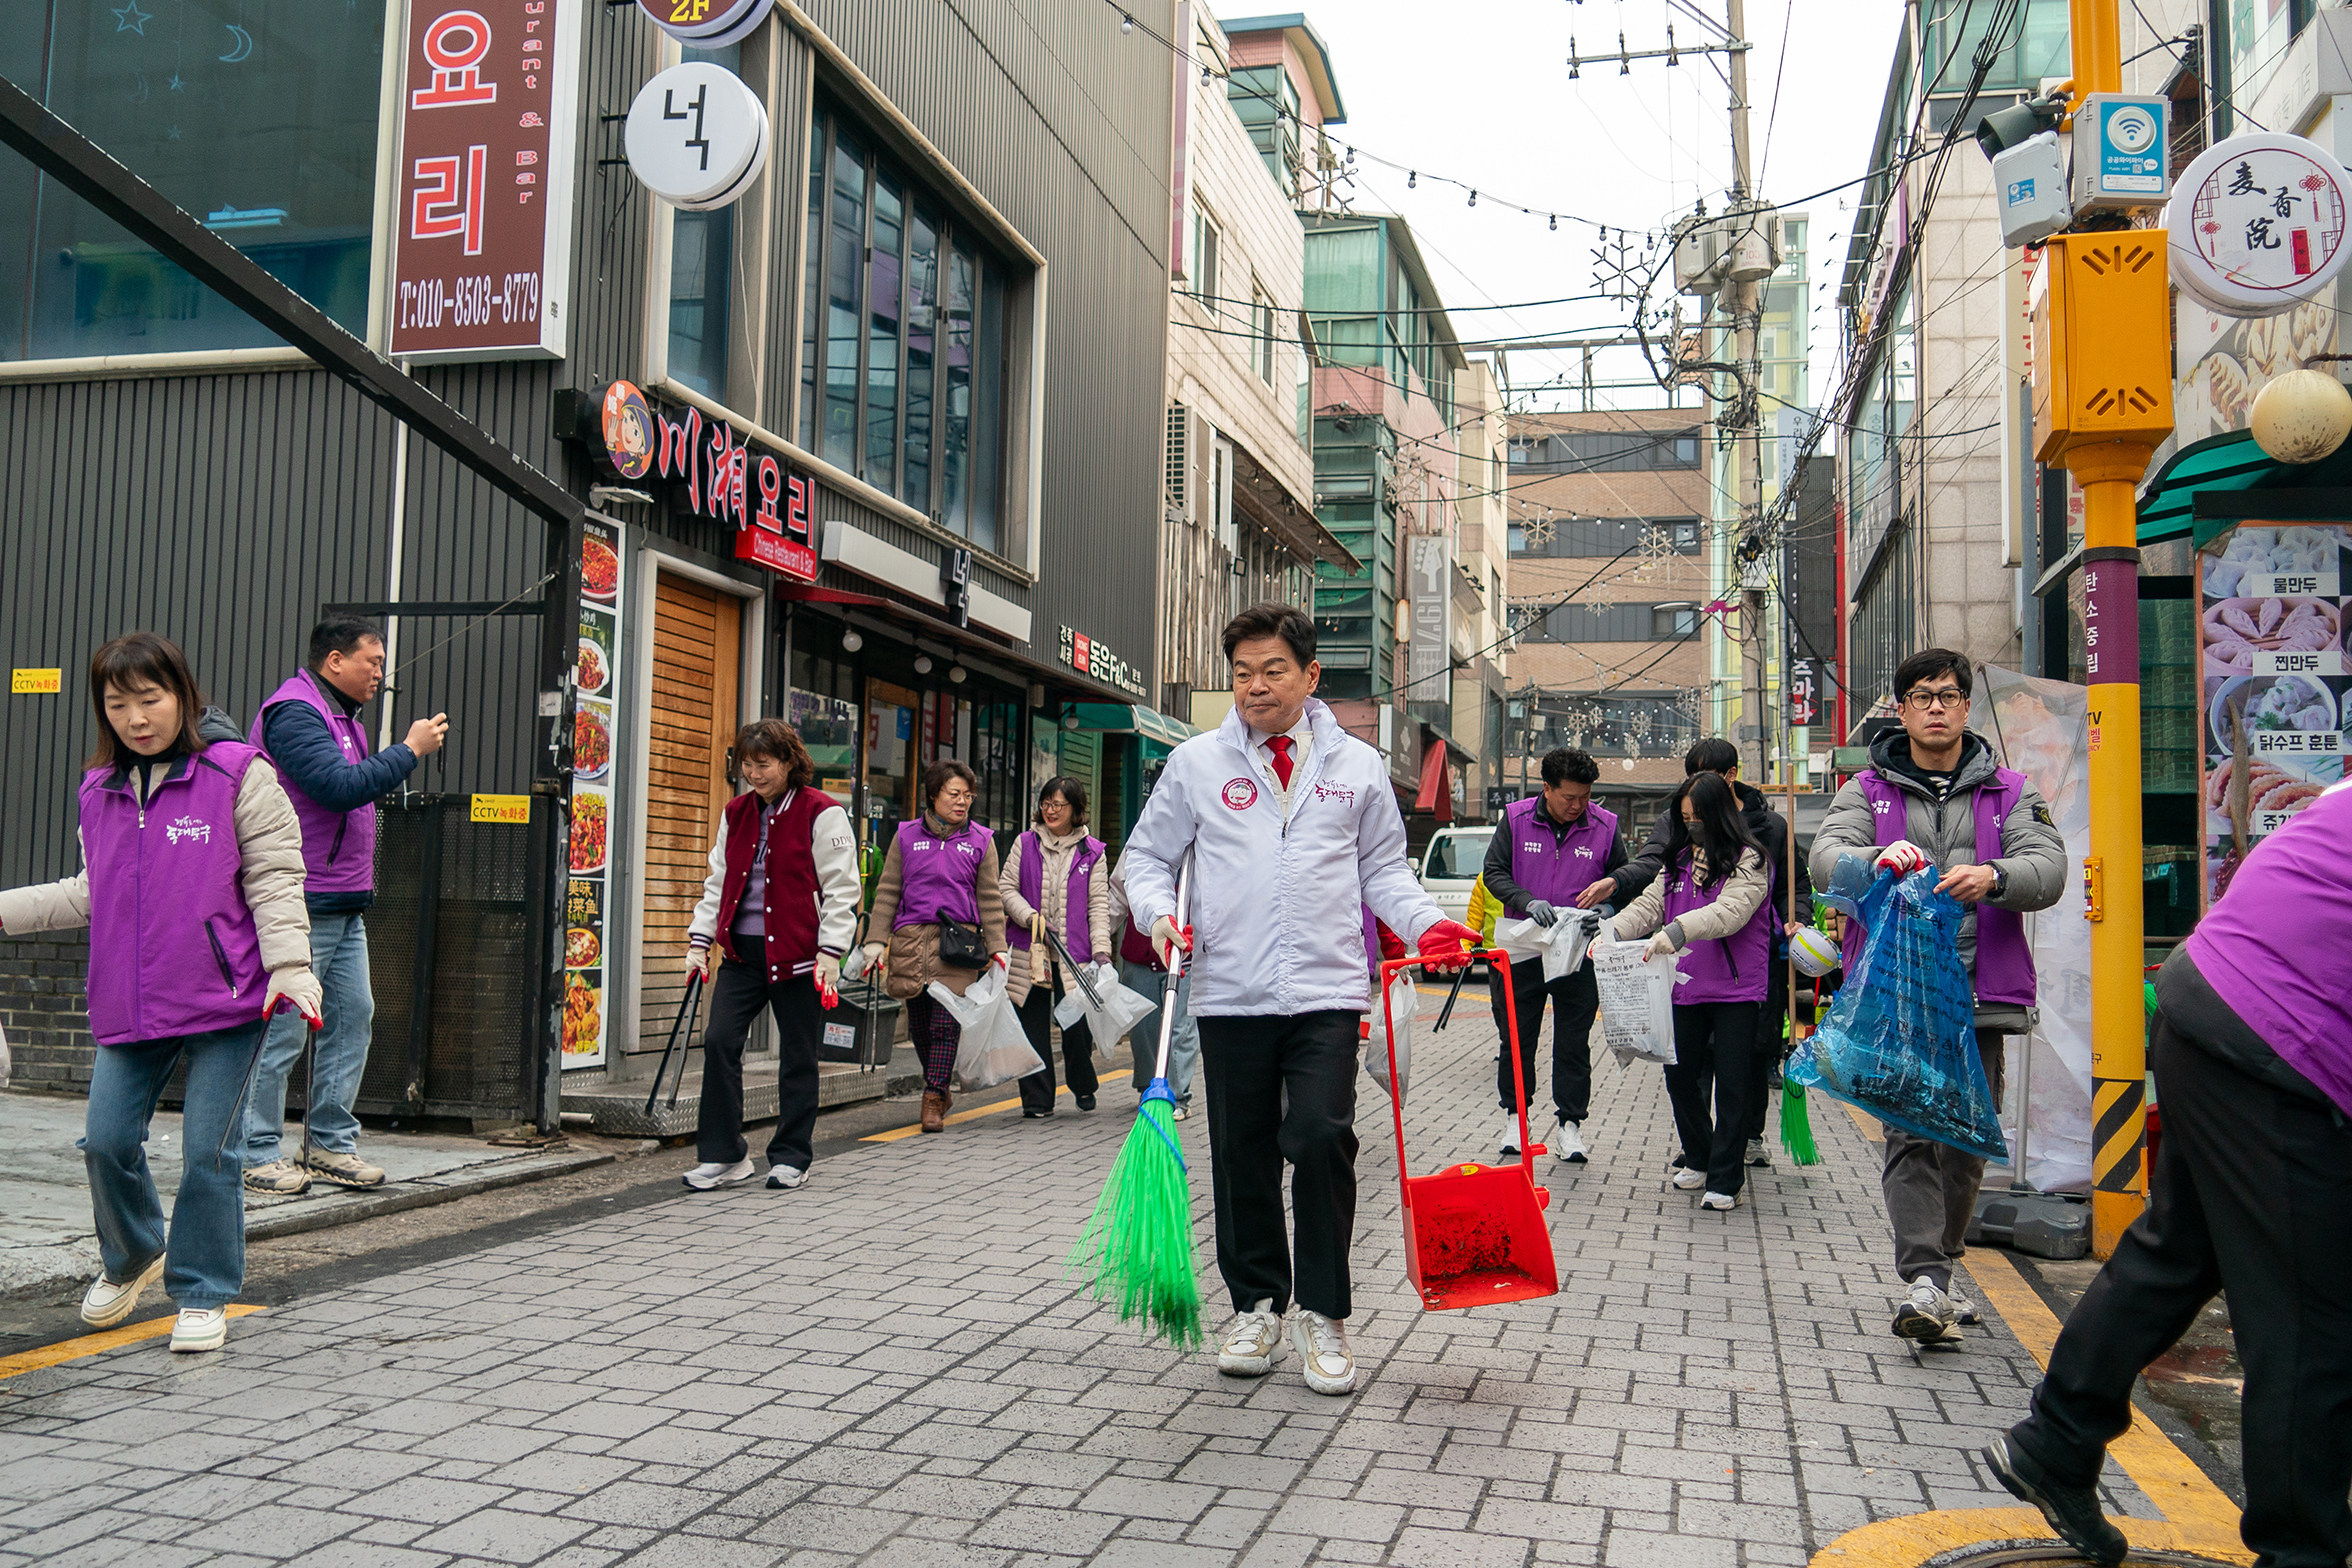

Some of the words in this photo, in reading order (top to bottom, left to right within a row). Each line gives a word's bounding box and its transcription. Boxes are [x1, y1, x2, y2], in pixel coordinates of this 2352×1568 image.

[669, 0, 710, 22] 2F
[519, 111, 544, 128] &
[2107, 156, 2144, 164] 공공와이파이
[516, 150, 538, 204] Bar
[400, 271, 539, 329] T:010-8503-8779
[753, 532, 774, 560] Chinese
[774, 540, 800, 570] Restaurant
[800, 550, 804, 572] &
[804, 552, 814, 575] Bar
[2273, 578, 2317, 594] 물만두
[2085, 572, 2098, 674] 탄소중립
[1060, 644, 1073, 665] 시공
[2275, 655, 2319, 671] 찐만두
[14, 679, 58, 690] CCTV녹화중
[2259, 735, 2304, 751] 닭수프
[2308, 734, 2338, 751] 훈툰
[1315, 783, 1354, 808] 동대문구
[473, 807, 526, 820] CCTV녹화중
[166, 824, 211, 845] 동대문구
[568, 879, 593, 898] 美味
